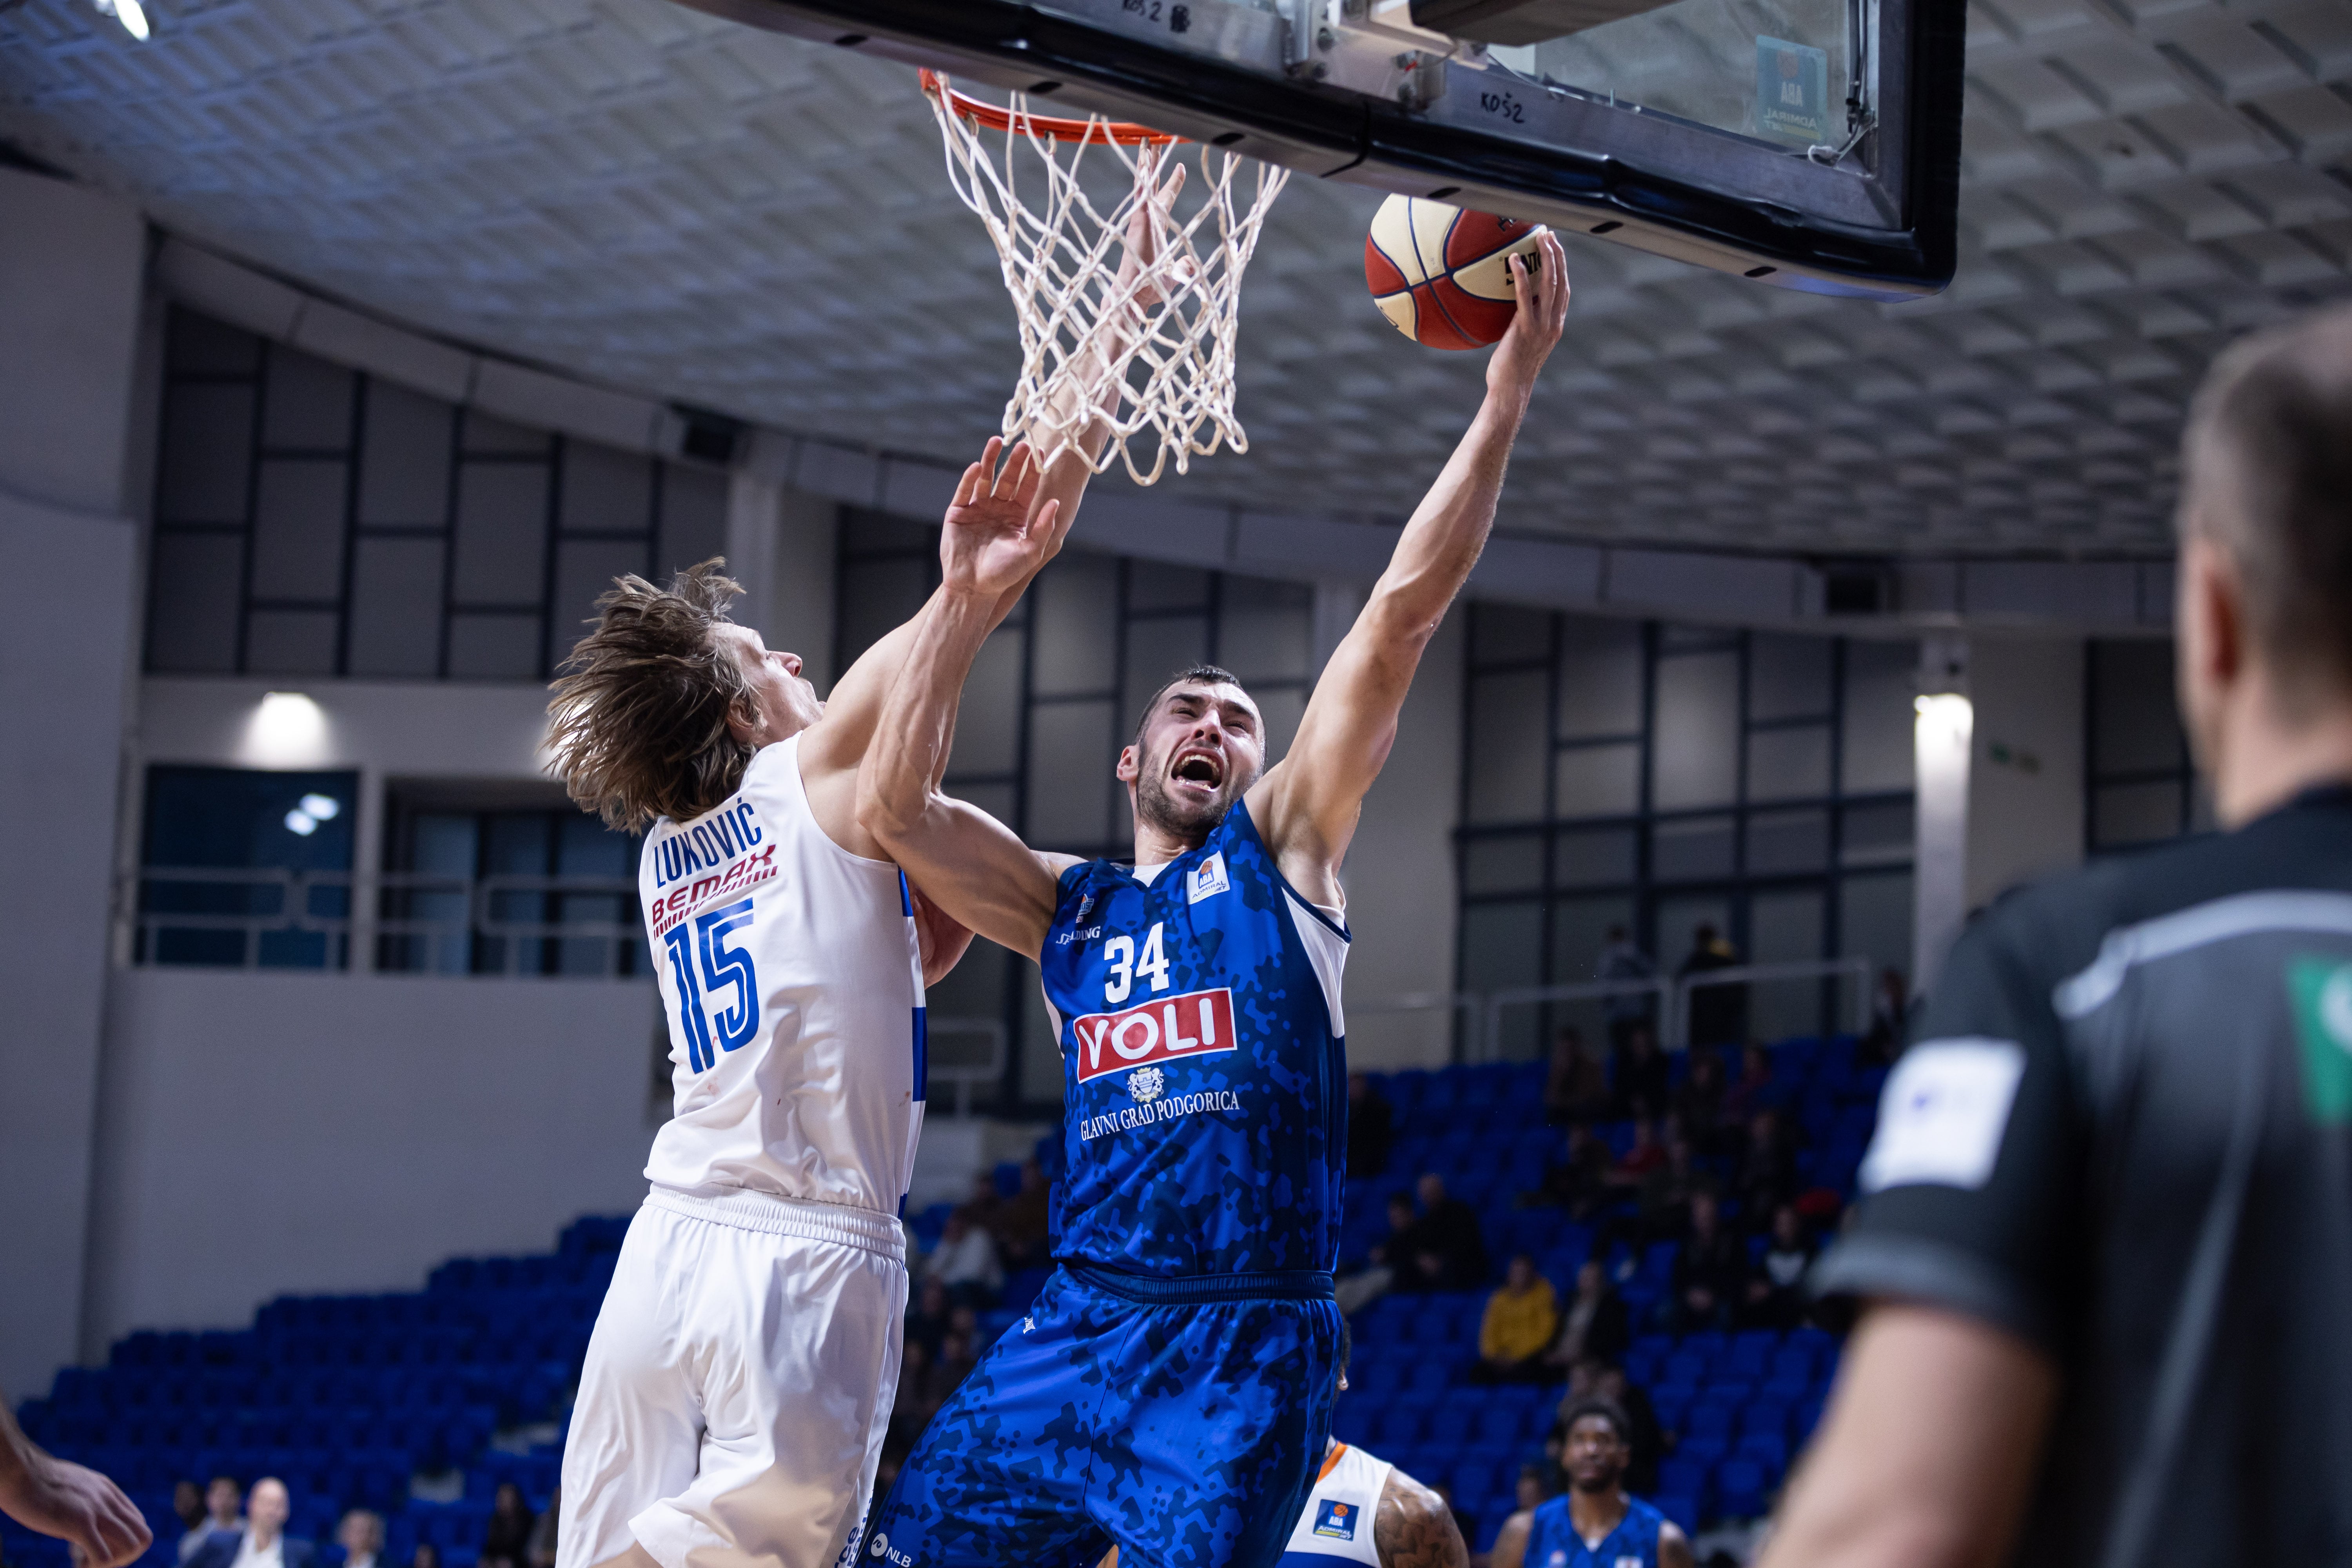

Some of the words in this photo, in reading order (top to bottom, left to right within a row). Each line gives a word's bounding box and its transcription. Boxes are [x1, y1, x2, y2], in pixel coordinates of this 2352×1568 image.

[654, 797, 762, 889] LUKOVIĆ
[652, 844, 776, 926] BEMAX
[1192, 880, 1226, 899] ADMIRAL
[1199, 873, 1213, 888] ABA
[664, 897, 760, 1075] 15
[1104, 922, 1169, 1003] 34
[1079, 998, 1215, 1069] VOLI
[1081, 1112, 1120, 1141] GLAVNI
[1120, 1103, 1155, 1130] GRAD
[1155, 1091, 1240, 1121] PODGORICA
[1318, 1525, 1352, 1537] ADMIRAL
[1328, 1516, 1343, 1527] ABA
[886, 1546, 911, 1568] NLB
